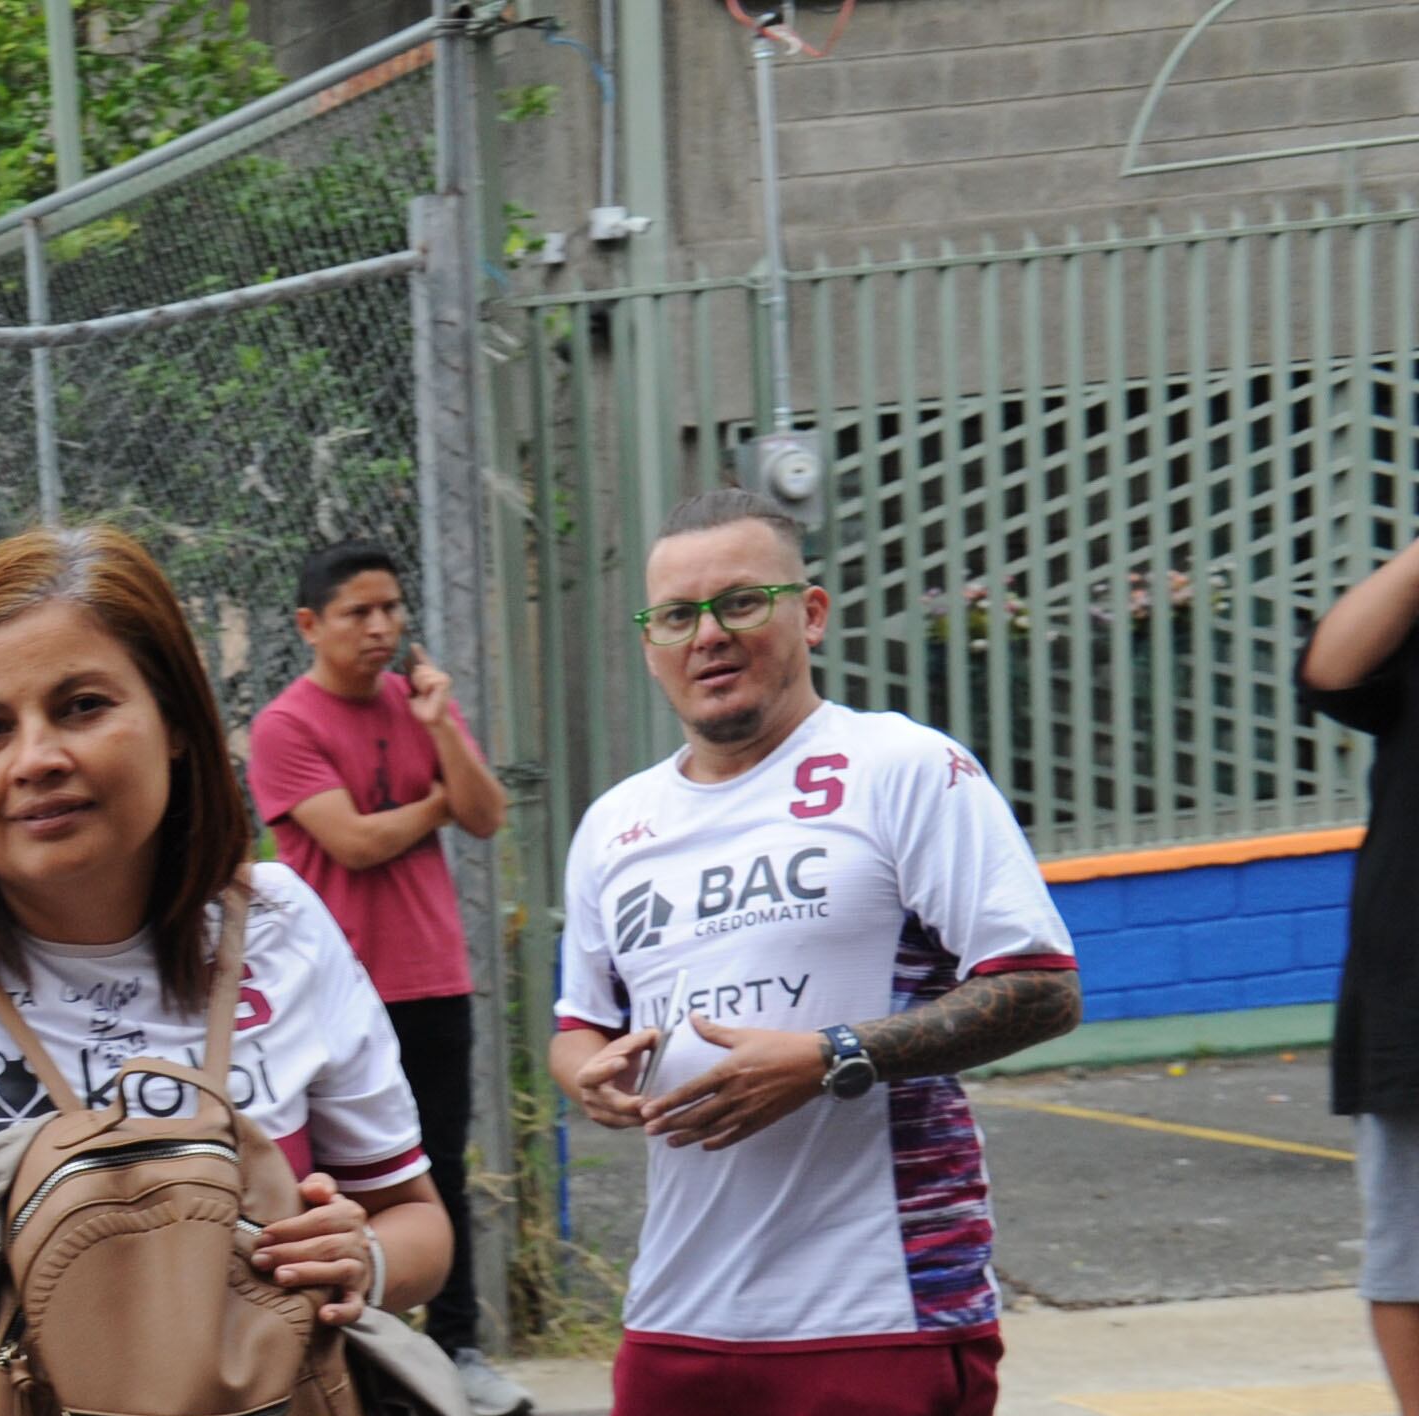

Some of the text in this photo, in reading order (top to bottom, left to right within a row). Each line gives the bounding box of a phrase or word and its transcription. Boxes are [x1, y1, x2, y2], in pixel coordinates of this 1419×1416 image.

[790, 753, 849, 820] S
[696, 847, 829, 919] BAC
[694, 902, 831, 937] CREDOMATIC
